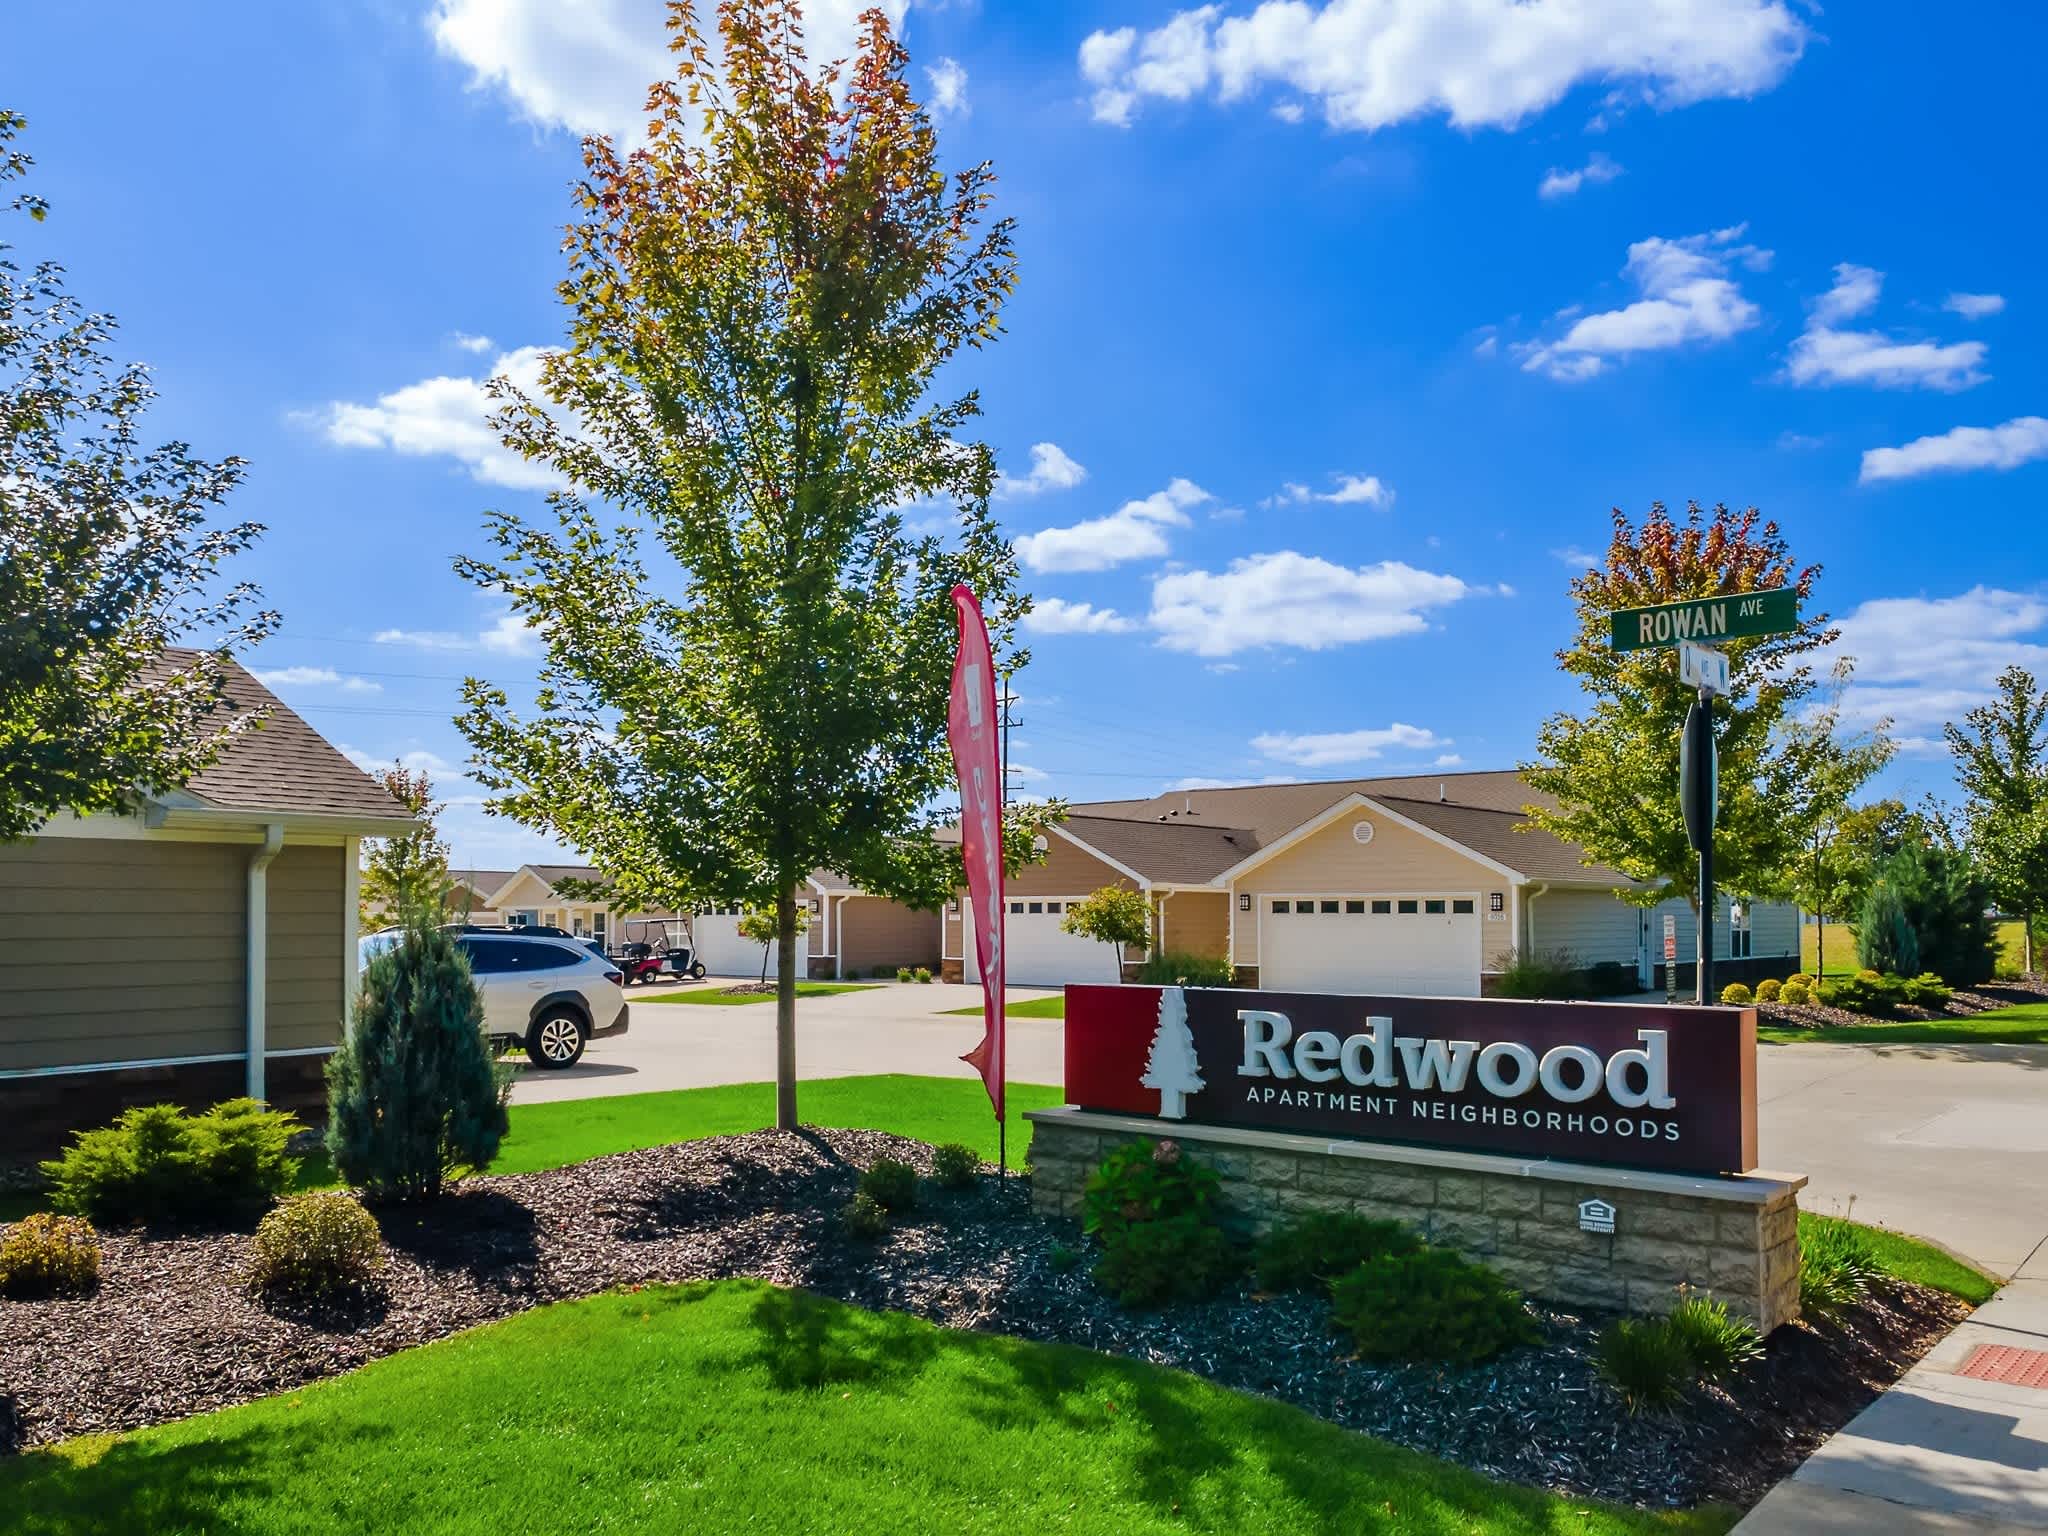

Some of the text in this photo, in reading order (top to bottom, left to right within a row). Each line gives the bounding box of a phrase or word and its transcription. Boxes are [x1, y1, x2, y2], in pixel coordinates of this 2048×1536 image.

[1639, 599, 1763, 643] ROWAN AVE
[1237, 1010, 1676, 1109] Redwood
[1247, 1087, 1680, 1140] APARTMENT NEIGHBORHOODS
